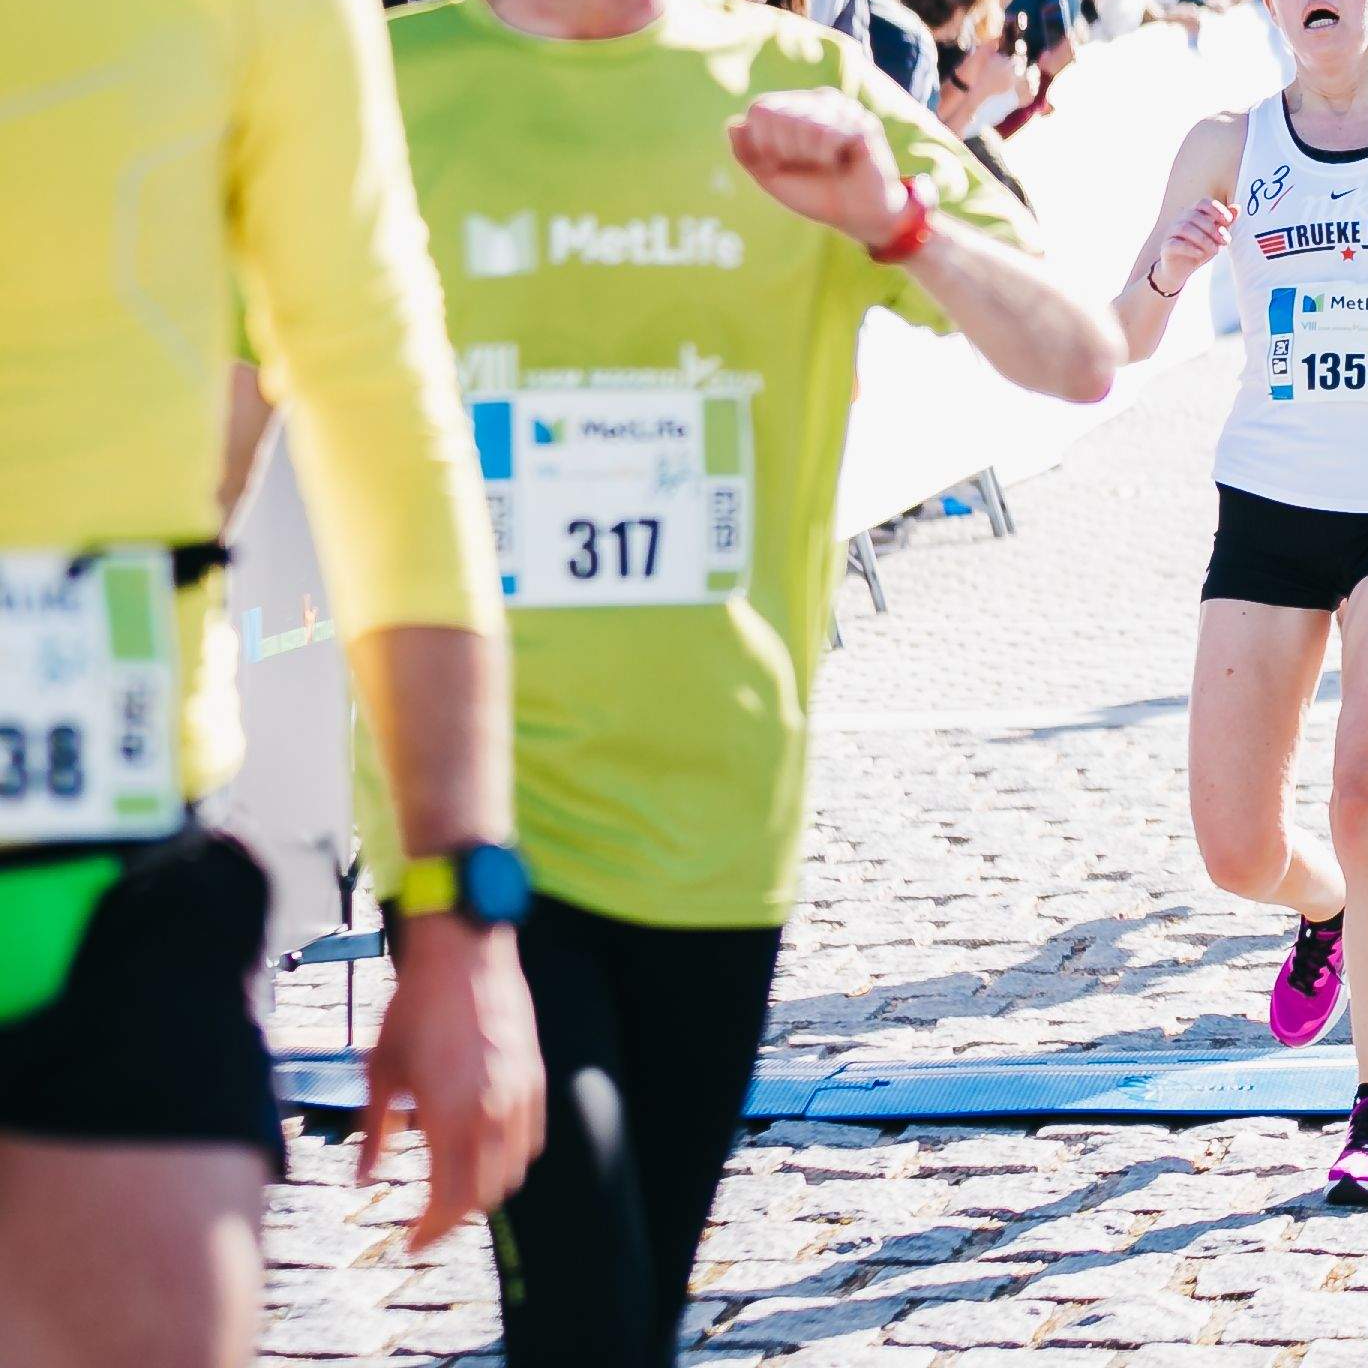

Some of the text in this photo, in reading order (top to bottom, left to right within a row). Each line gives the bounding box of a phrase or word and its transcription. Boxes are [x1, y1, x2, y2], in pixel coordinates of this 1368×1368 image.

[547, 214, 745, 269] MetLife
[1286, 221, 1361, 249] TRUEKE
[567, 518, 662, 580] 317
